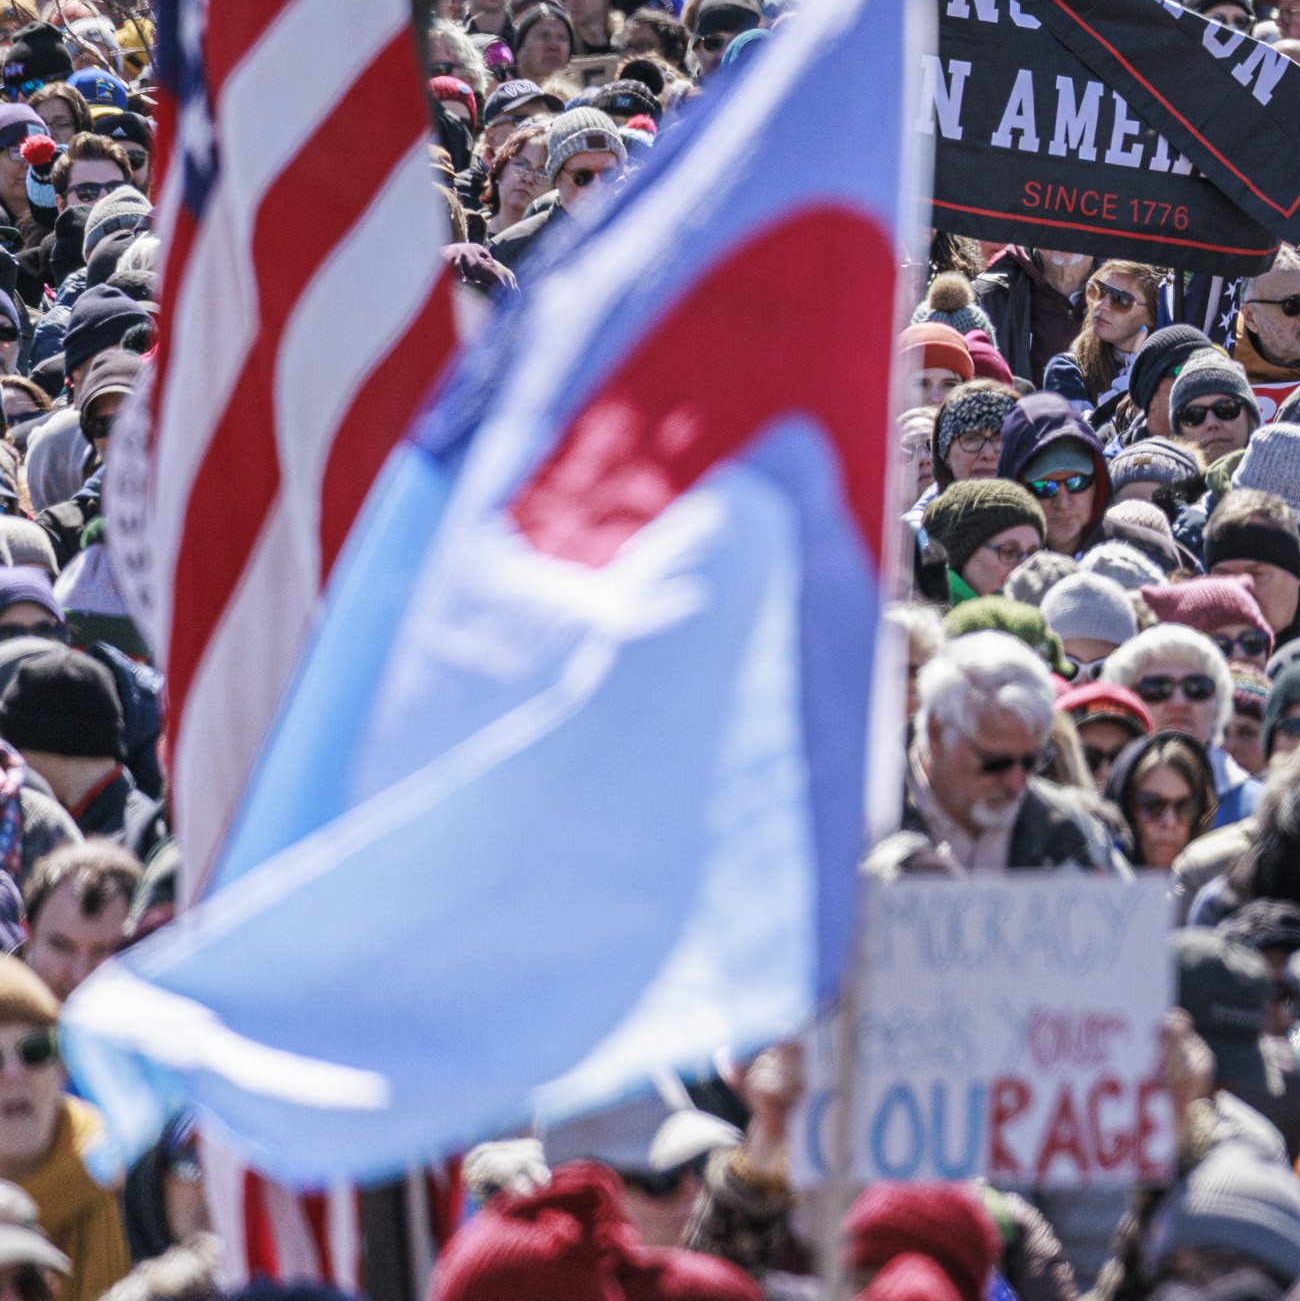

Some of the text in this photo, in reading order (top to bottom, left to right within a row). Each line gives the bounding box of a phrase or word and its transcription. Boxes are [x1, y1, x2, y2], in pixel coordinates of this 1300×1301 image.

[1021, 180, 1190, 231] SINCE 1776
[805, 1074, 1176, 1182] COURAGE
